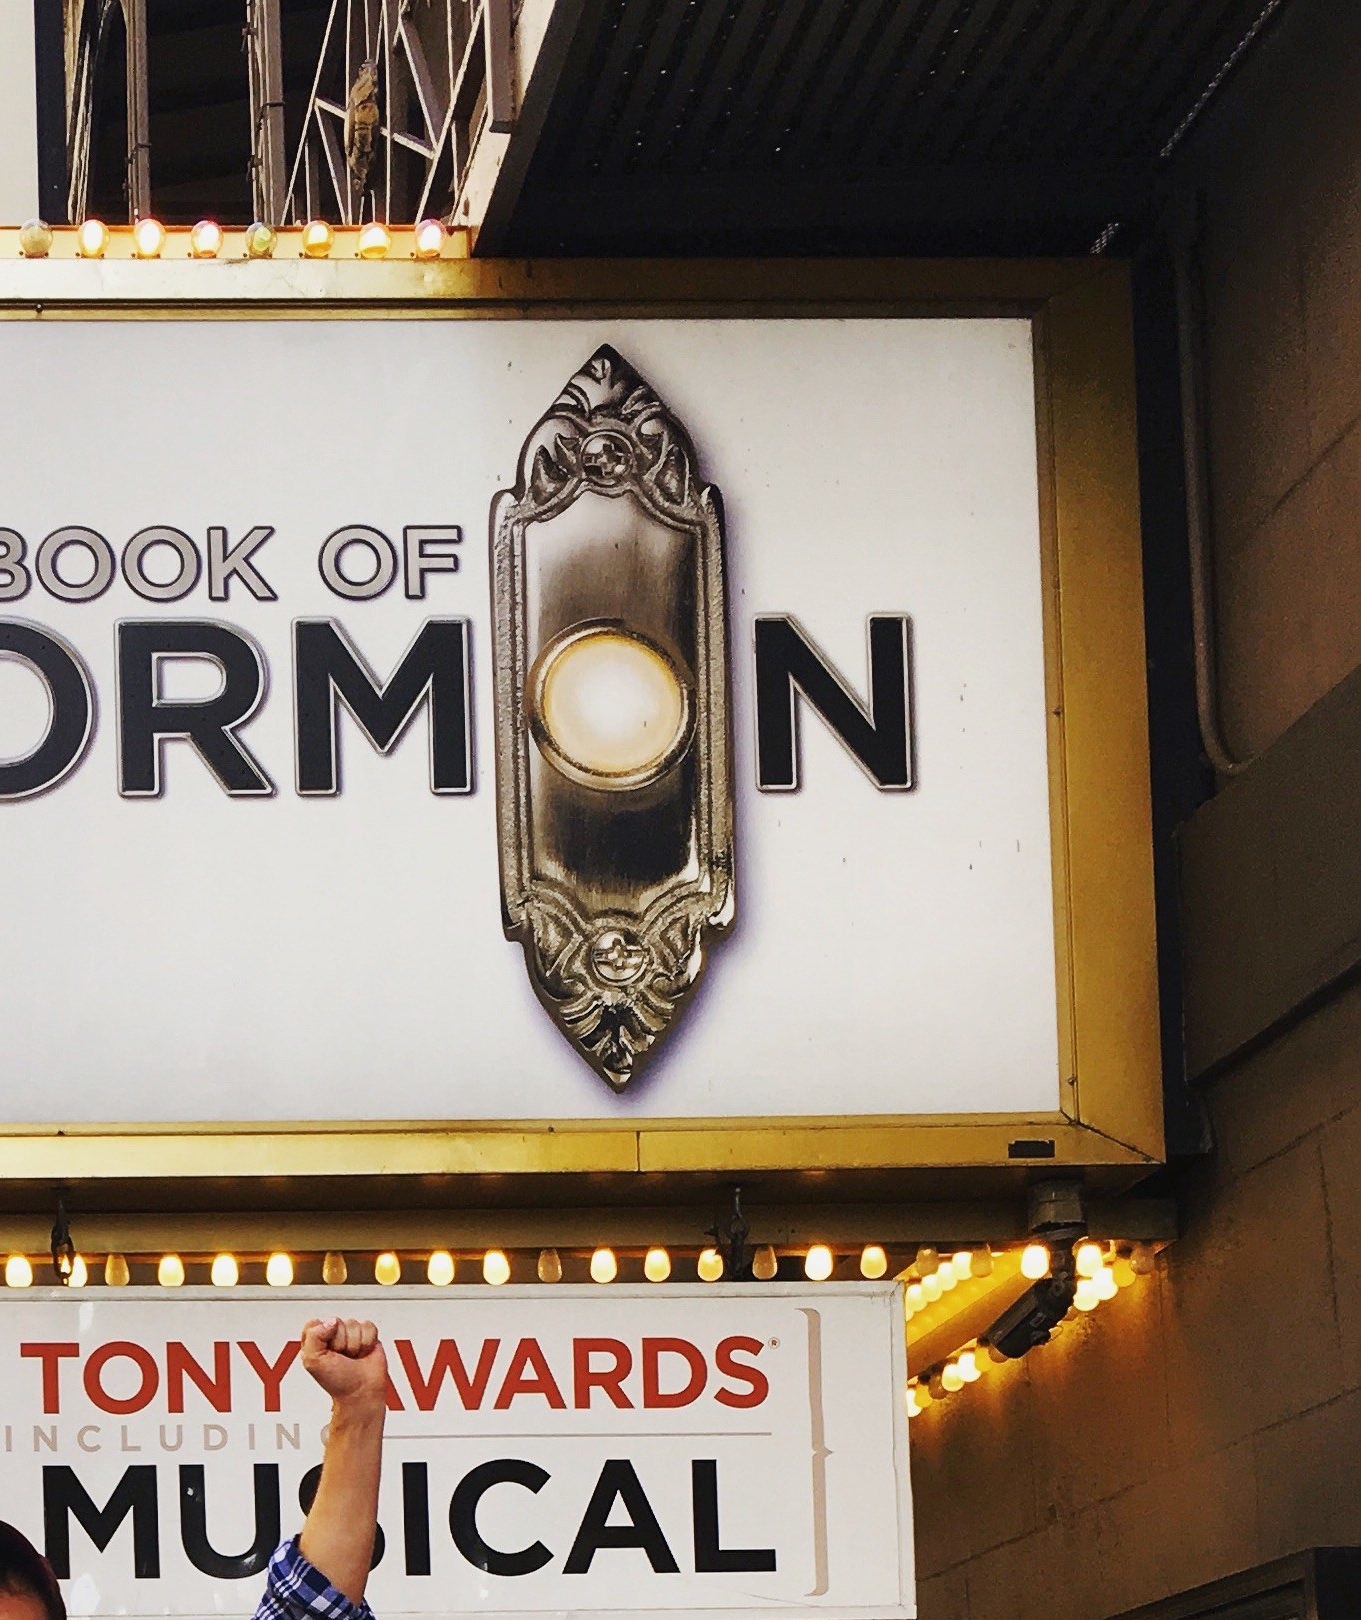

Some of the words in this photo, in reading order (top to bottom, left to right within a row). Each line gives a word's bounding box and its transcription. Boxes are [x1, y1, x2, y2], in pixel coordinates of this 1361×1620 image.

[319, 524, 462, 600] OF
[20, 1340, 302, 1415] TONY
[385, 1336, 770, 1411] WARDS
[5, 1423, 331, 1452] INCLUDIN
[42, 1458, 777, 1580] MUICAL
